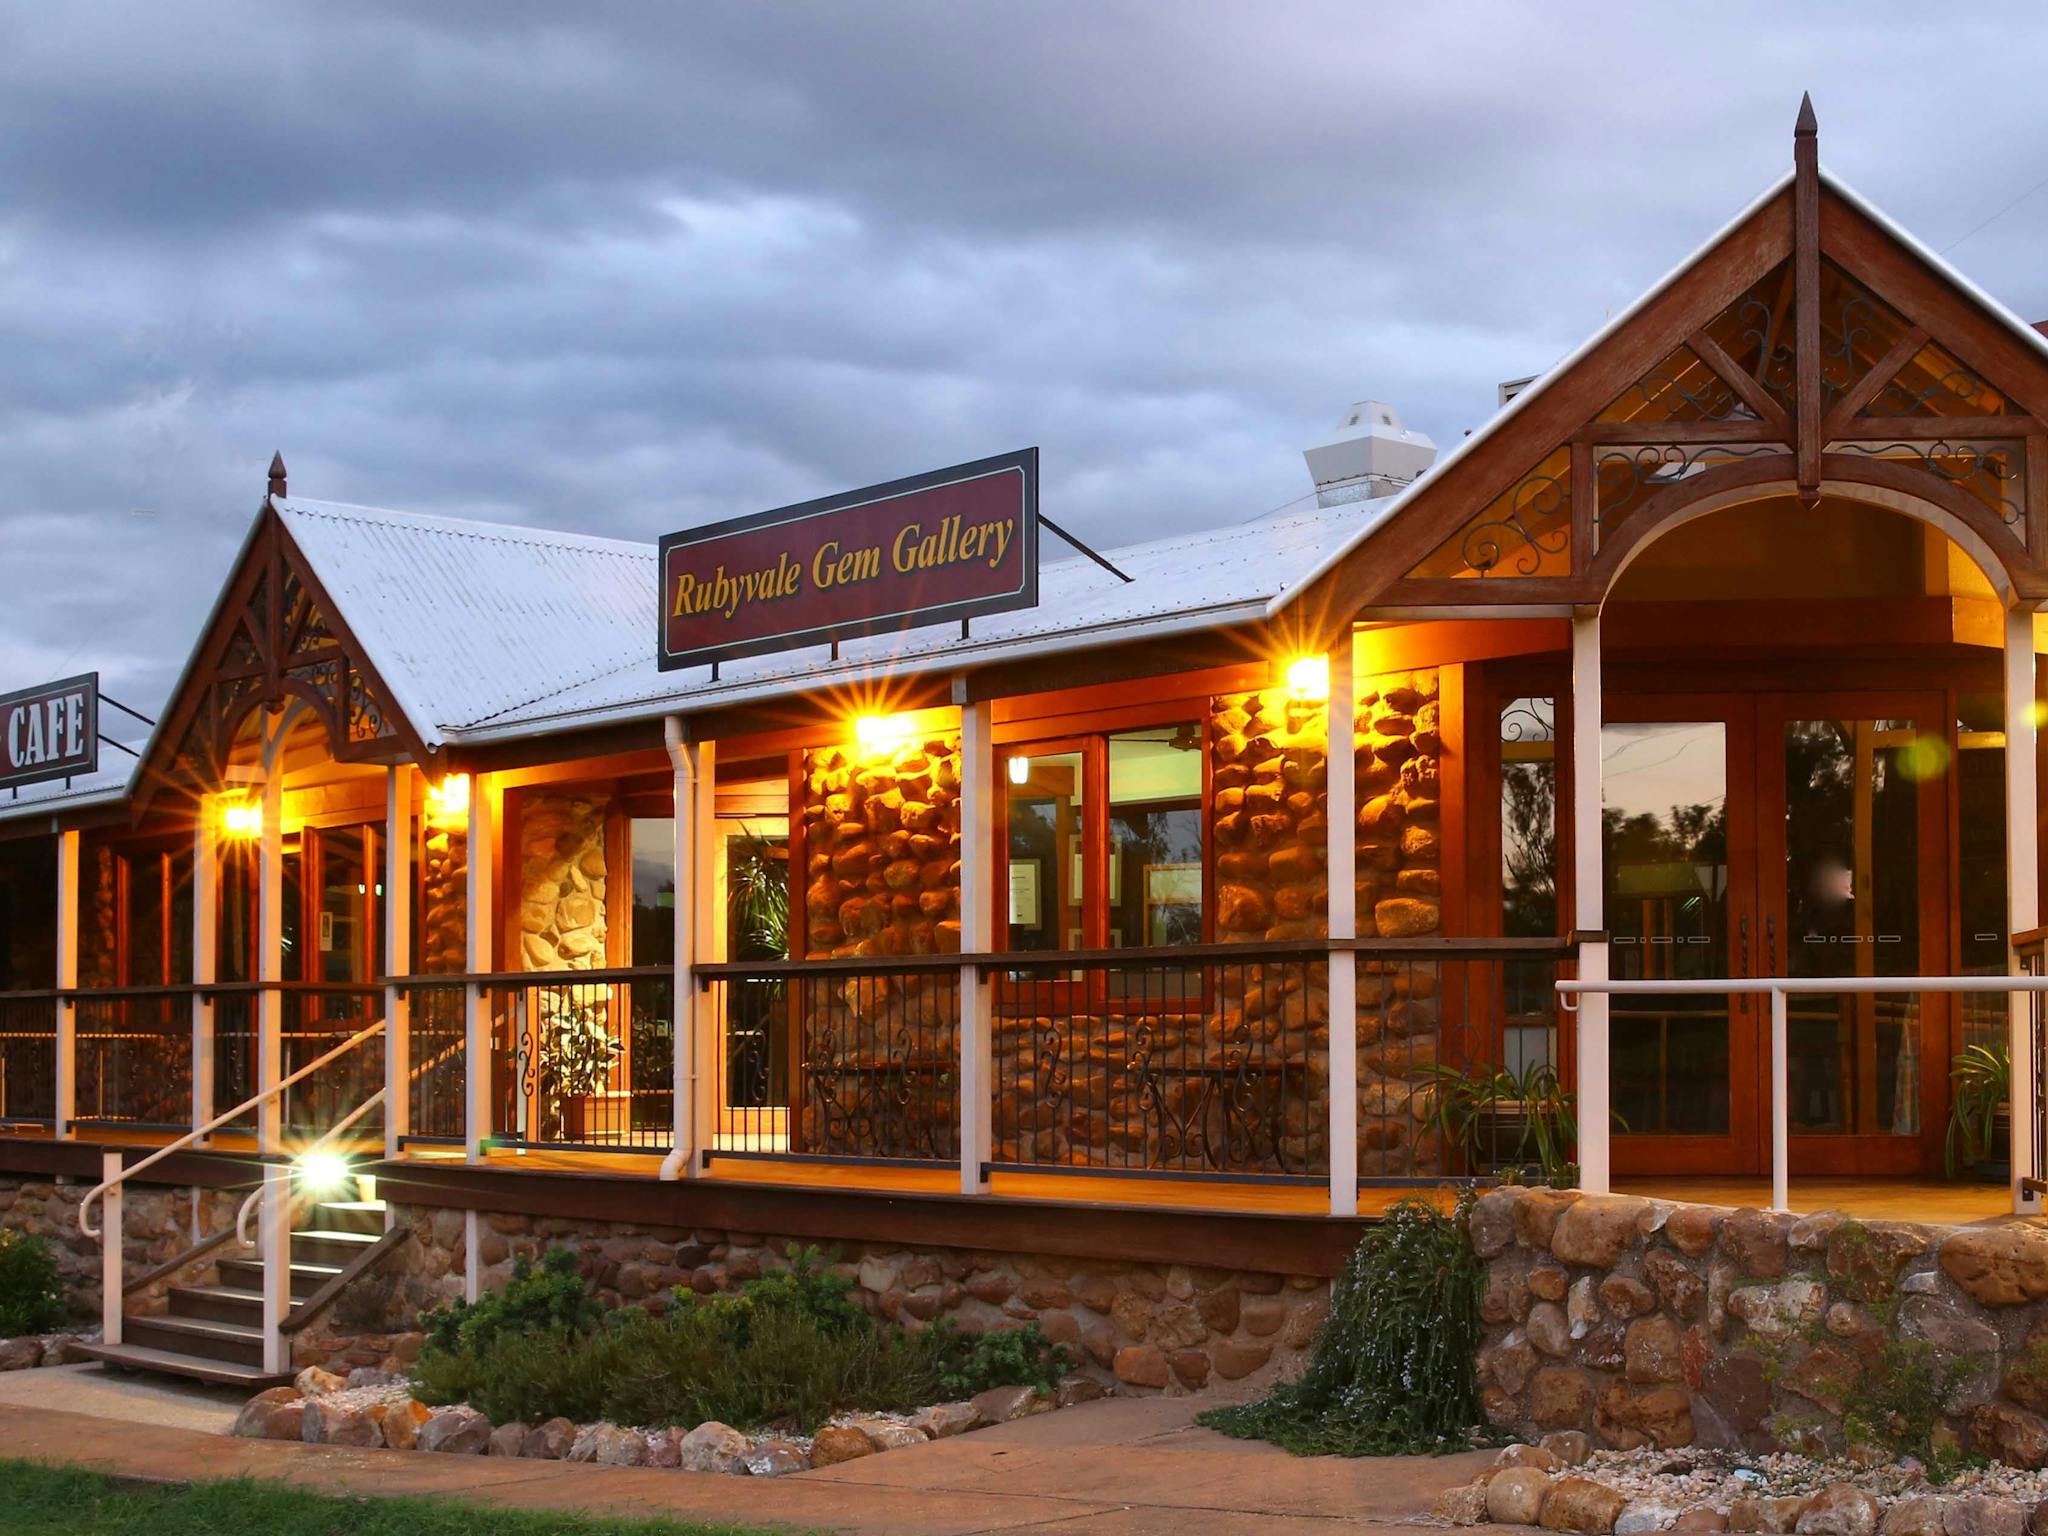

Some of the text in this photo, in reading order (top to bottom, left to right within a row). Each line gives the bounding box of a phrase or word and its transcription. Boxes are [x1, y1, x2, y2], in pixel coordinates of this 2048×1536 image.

[673, 514, 1014, 618] Rubyvale Gem Gallery
[8, 693, 84, 768] CAFE
